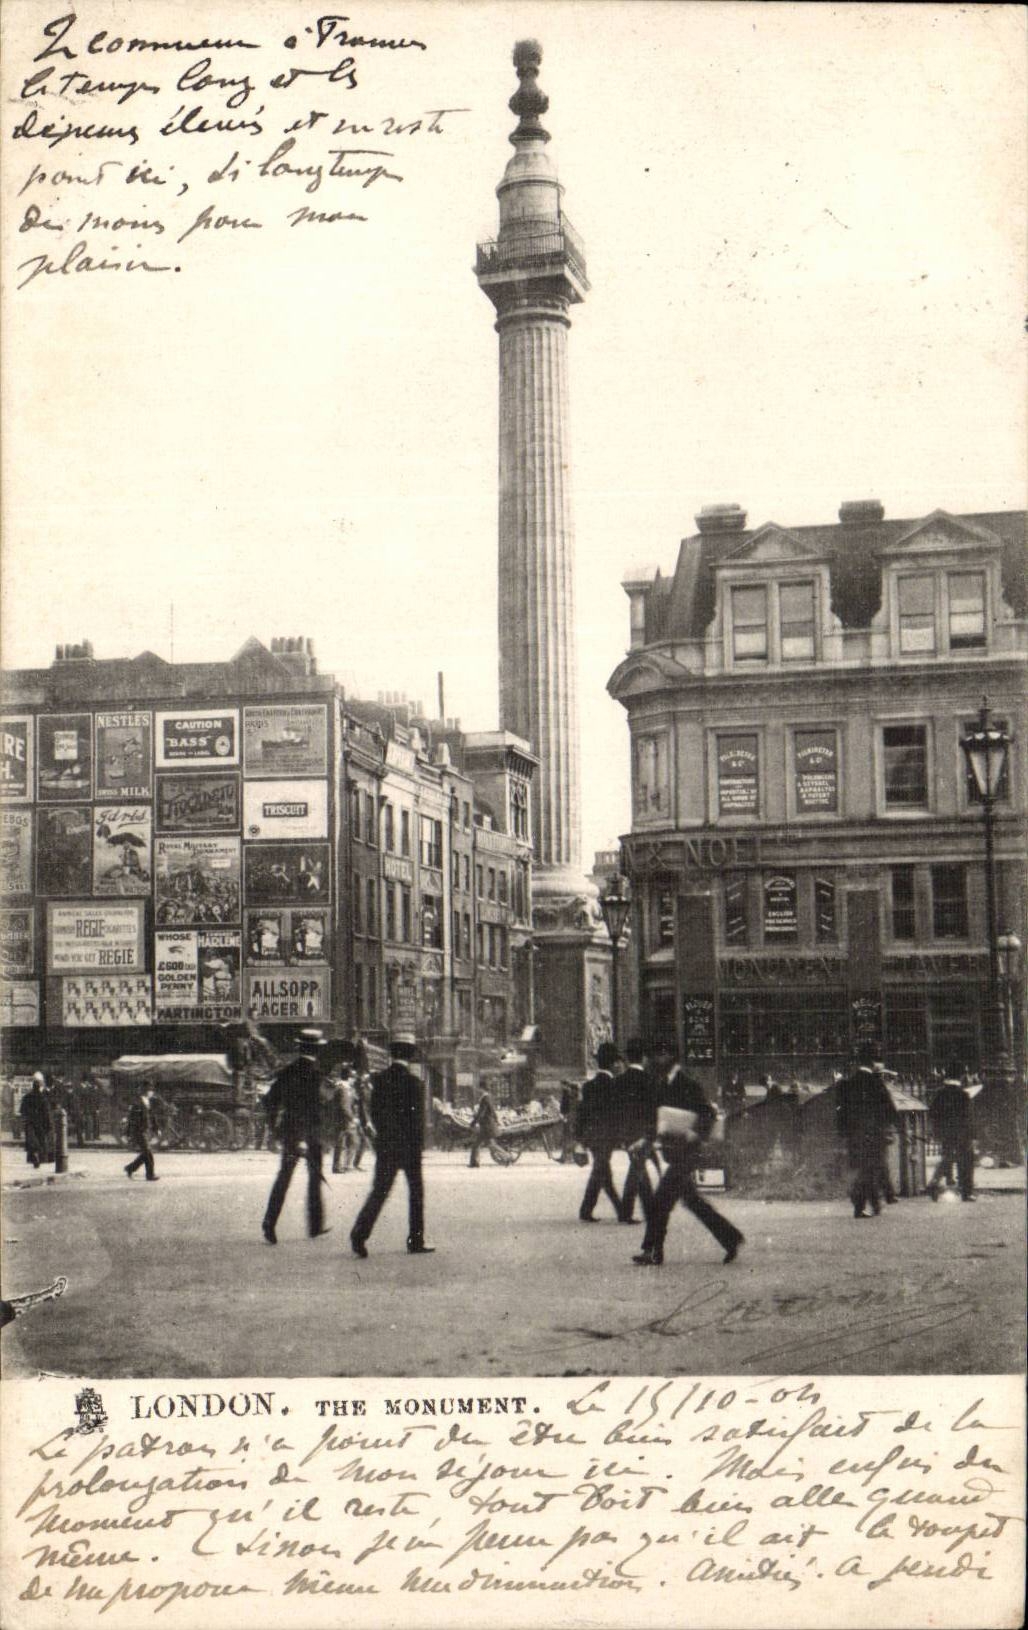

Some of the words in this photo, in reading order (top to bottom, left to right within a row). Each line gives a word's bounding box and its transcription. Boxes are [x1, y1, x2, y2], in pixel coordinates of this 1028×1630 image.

[177, 58, 255, 109] long
[270, 68, 326, 88] et
[284, 110, 329, 134] et
[175, 720, 222, 730] CAUTION
[120, 786, 150, 796] MILK
[264, 804, 306, 816] TRISCUIT
[384, 861, 412, 882] HOTEL
[76, 920, 106, 938] REGIE
[158, 933, 192, 941] WHOSE
[98, 948, 134, 966] REGIE
[158, 974, 196, 982] GOLDEN
[160, 982, 194, 990] PENNY
[333, 1457, 418, 1484] mon
